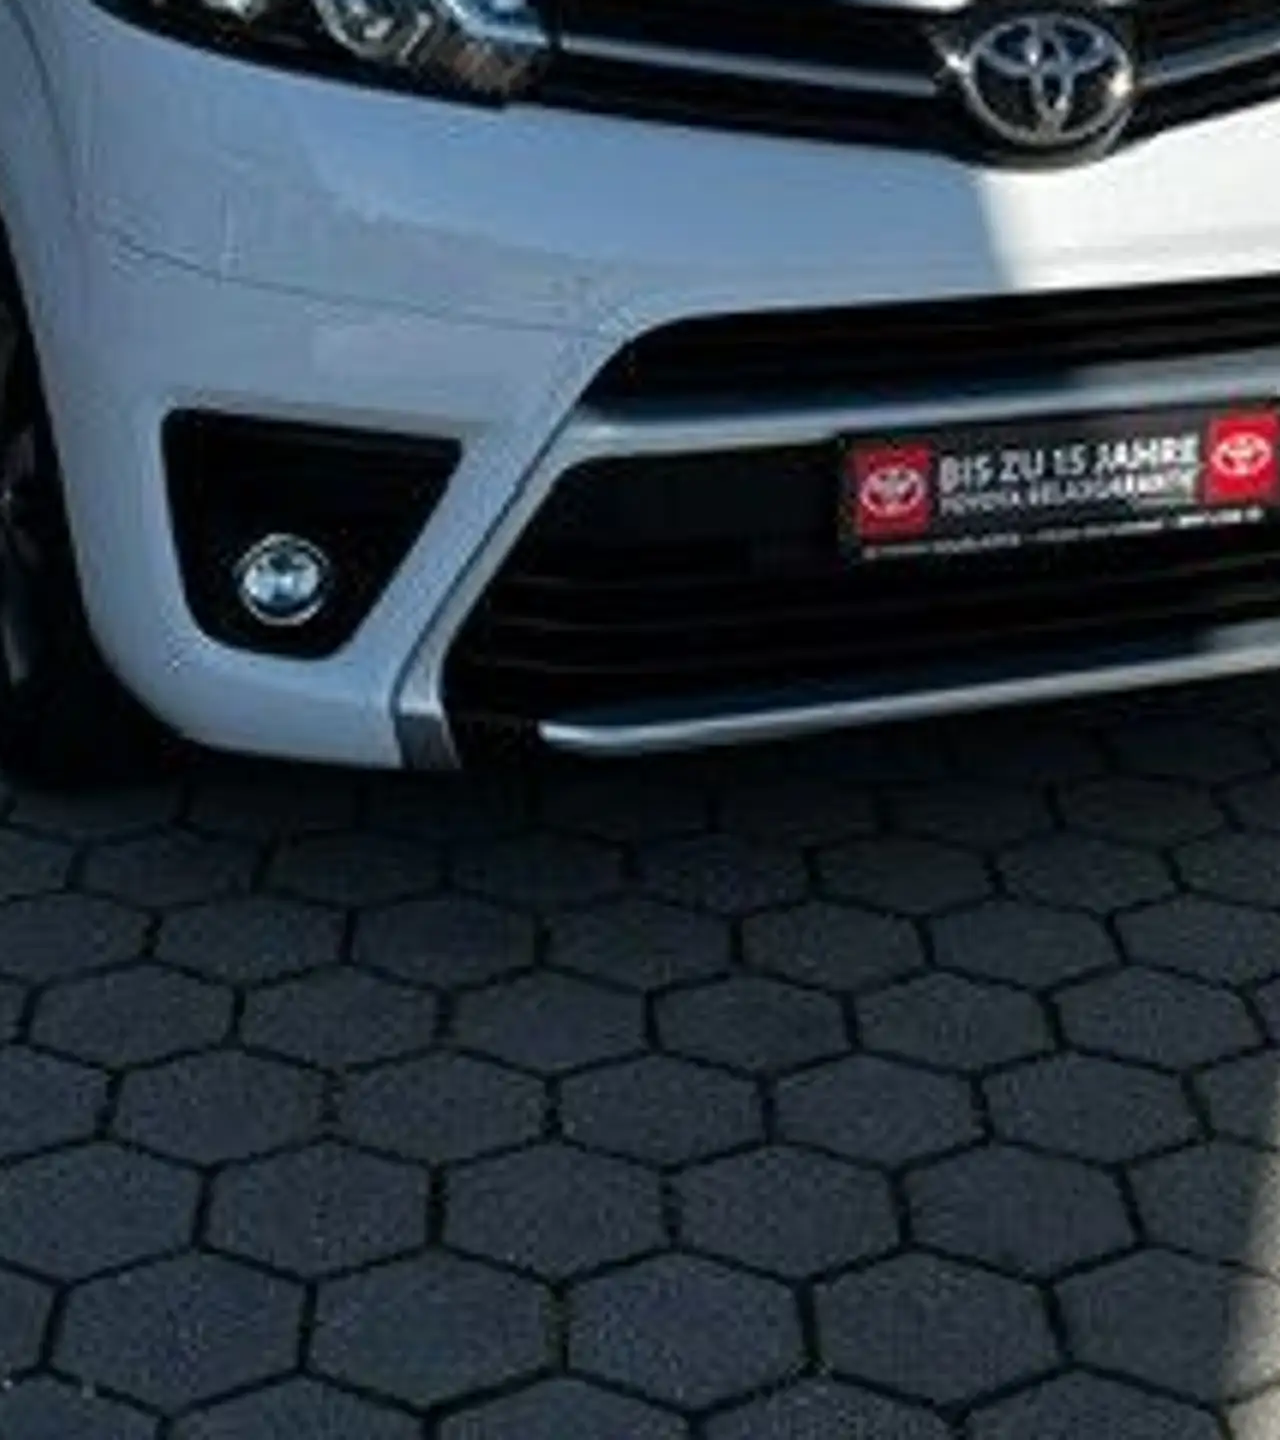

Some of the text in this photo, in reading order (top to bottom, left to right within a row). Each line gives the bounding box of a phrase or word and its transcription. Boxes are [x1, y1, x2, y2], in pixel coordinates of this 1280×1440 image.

[938, 455, 995, 492] BIS
[999, 449, 1044, 483] ZU
[1052, 443, 1088, 477] 15
[1094, 433, 1200, 471] JAHRE
